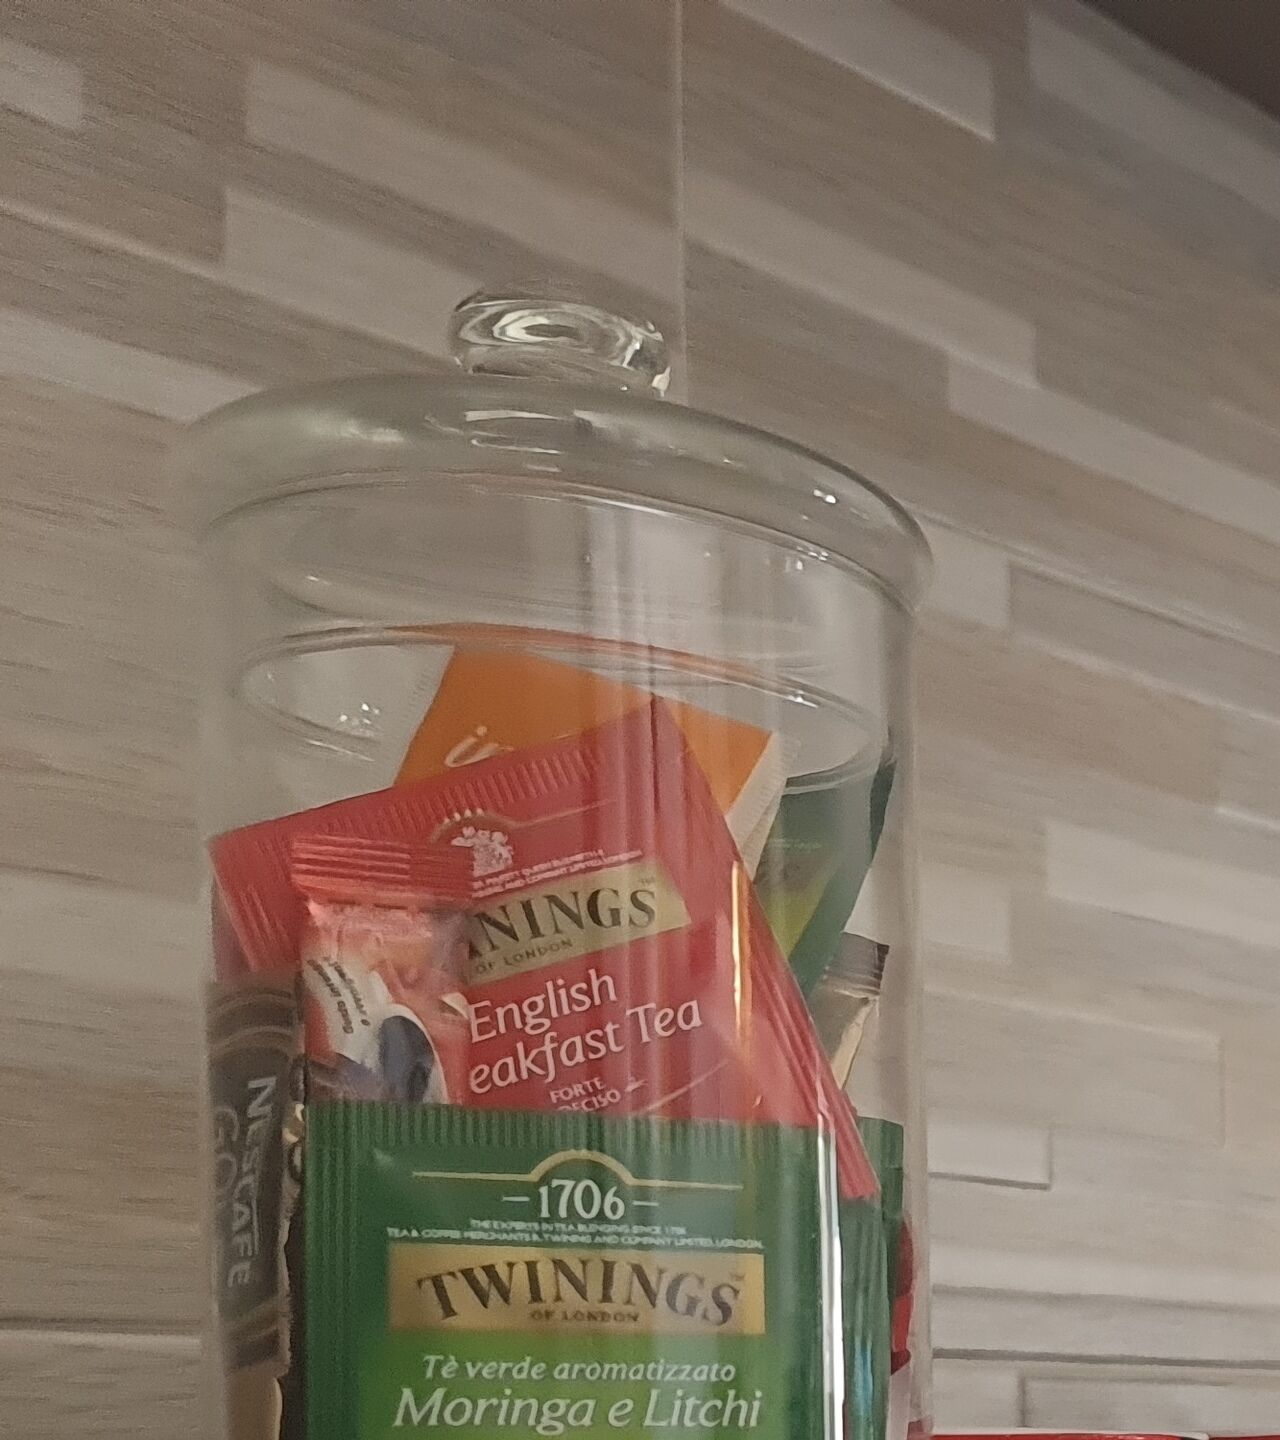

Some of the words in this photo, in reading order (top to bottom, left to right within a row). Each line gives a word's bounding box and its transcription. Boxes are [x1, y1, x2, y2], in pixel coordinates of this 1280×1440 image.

[468, 887, 656, 960] NINGS
[504, 937, 574, 967] LONDON
[469, 968, 618, 1044] English
[469, 1022, 625, 1094] eakfast
[625, 999, 703, 1044] Tea
[550, 1076, 607, 1104] FORTE
[538, 1178, 627, 1220] 1706
[416, 1258, 741, 1327] TWININGS
[561, 1310, 640, 1323] LONDON
[423, 1355, 459, 1380] Tè
[466, 1356, 546, 1380] verde
[553, 1358, 736, 1383] aromatizzato
[392, 1387, 595, 1436] Moringa
[607, 1398, 634, 1427] e
[642, 1388, 763, 1428] Litchi
